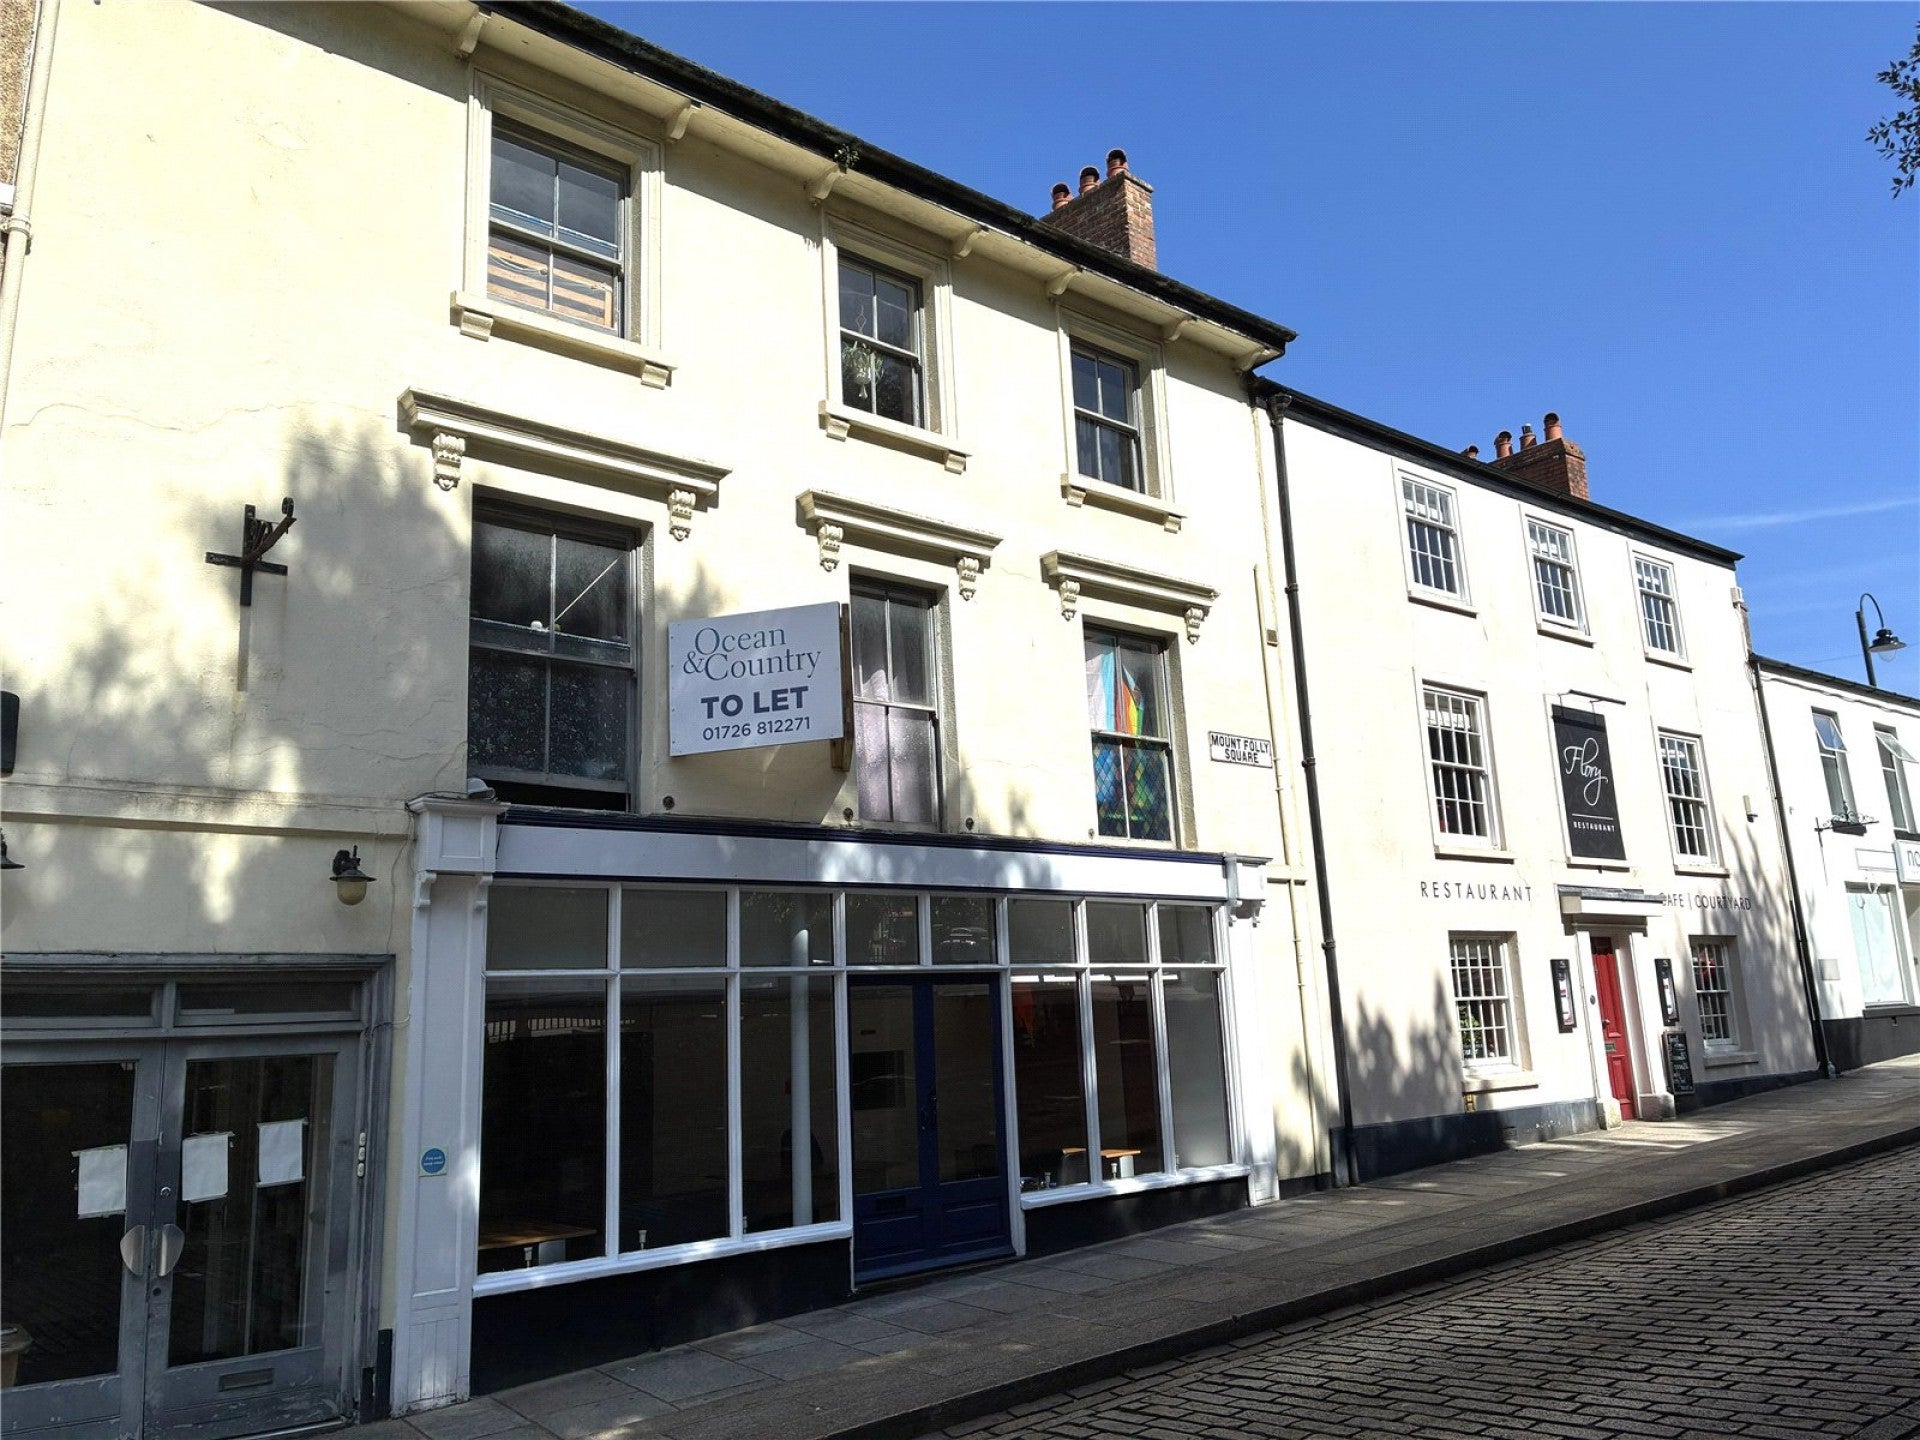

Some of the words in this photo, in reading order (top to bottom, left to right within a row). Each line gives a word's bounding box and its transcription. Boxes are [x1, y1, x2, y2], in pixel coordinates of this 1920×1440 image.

[695, 627, 786, 655] Ocean
[701, 694, 744, 719] TO
[753, 686, 808, 714] LET
[703, 723, 751, 740] 01726
[757, 717, 810, 734] 812271
[1211, 734, 1241, 749] MOUNT
[1244, 740, 1269, 753] FOLLY
[1225, 749, 1259, 763] SQUARE
[1573, 821, 1615, 832] RESTAURANT
[1420, 881, 1531, 901] RESTAURANT
[1695, 895, 1752, 910] COURTYARD
